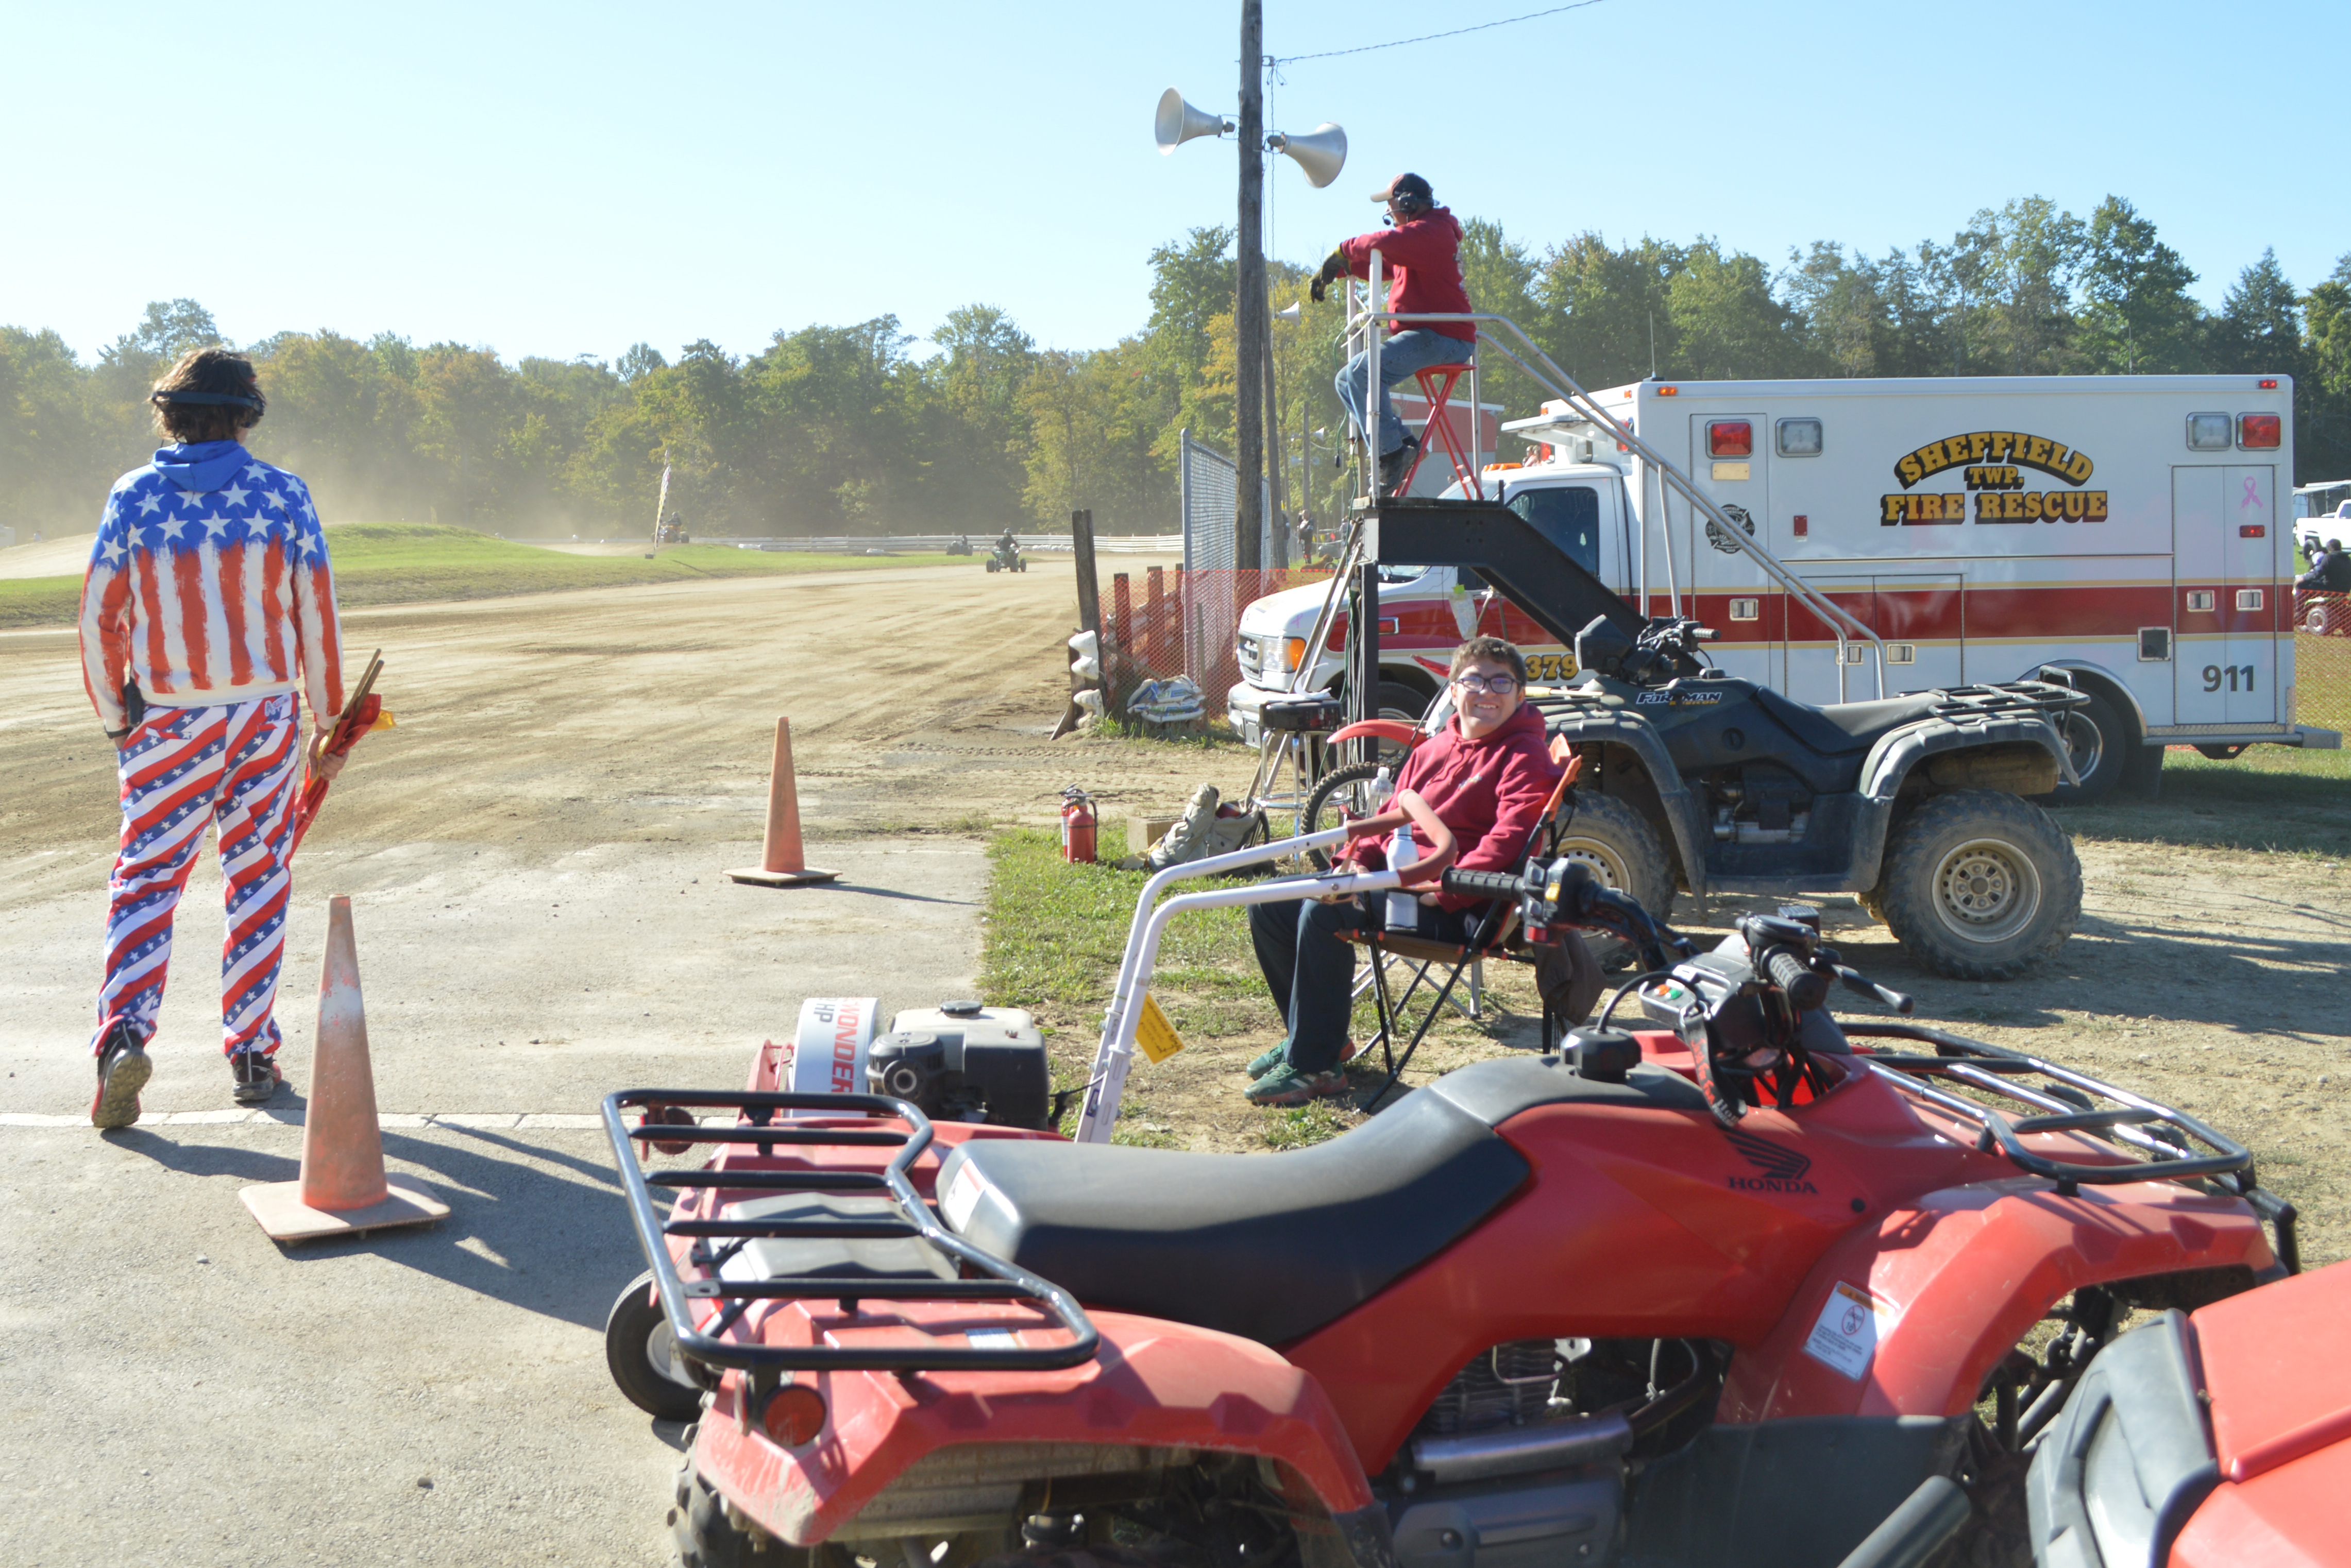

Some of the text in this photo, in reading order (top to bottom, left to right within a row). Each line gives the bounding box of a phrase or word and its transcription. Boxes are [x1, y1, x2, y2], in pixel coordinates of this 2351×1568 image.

[1894, 431, 2094, 489] SHEFFIELD
[1964, 466, 2024, 490] TWP.
[1881, 490, 2107, 526] FIRE RESCUE
[1525, 654, 1579, 682] 379
[2202, 664, 2254, 692] 911
[1636, 692, 1722, 704] FORMAN
[1728, 1177, 1818, 1194] HONDA
